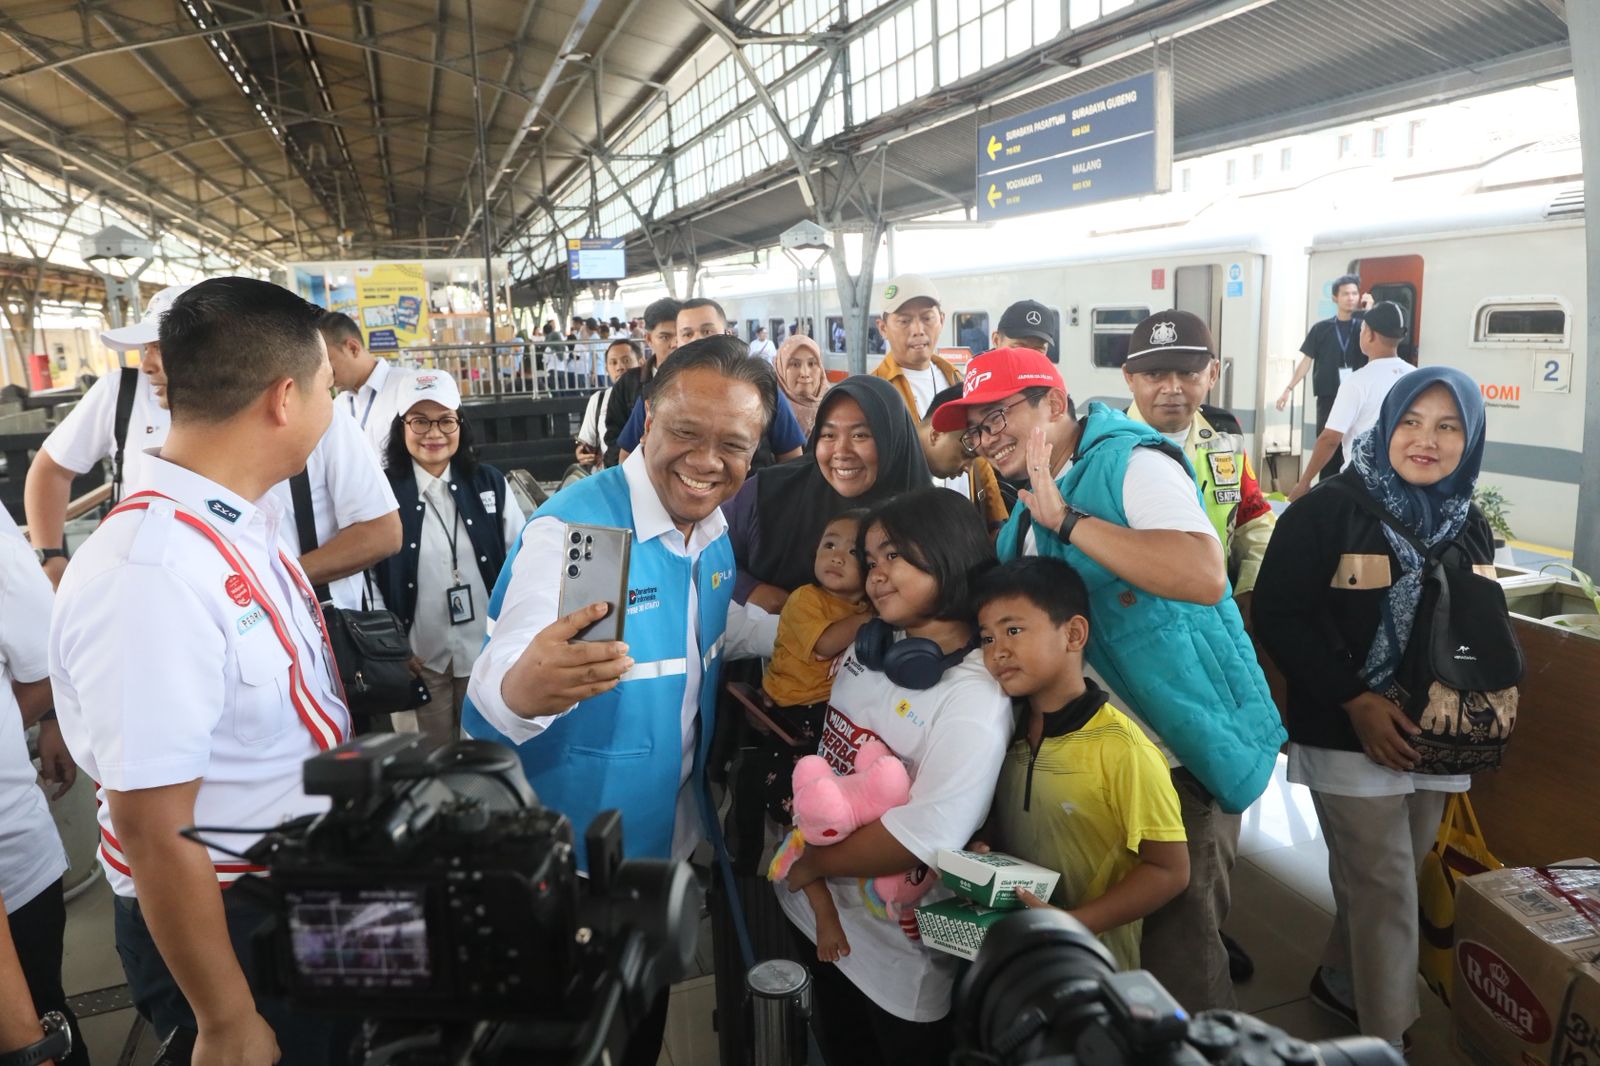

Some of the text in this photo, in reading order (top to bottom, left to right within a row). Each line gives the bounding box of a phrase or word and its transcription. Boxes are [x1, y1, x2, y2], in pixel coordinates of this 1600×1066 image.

[1106, 90, 1137, 110] GUBENG
[1072, 158, 1102, 175] MALANG
[1006, 173, 1043, 190] YOGYAKARTA
[1543, 359, 1560, 382] 2
[1480, 384, 1520, 401] OMI
[829, 710, 856, 741] MUDIK
[1466, 954, 1534, 1035] Roma
